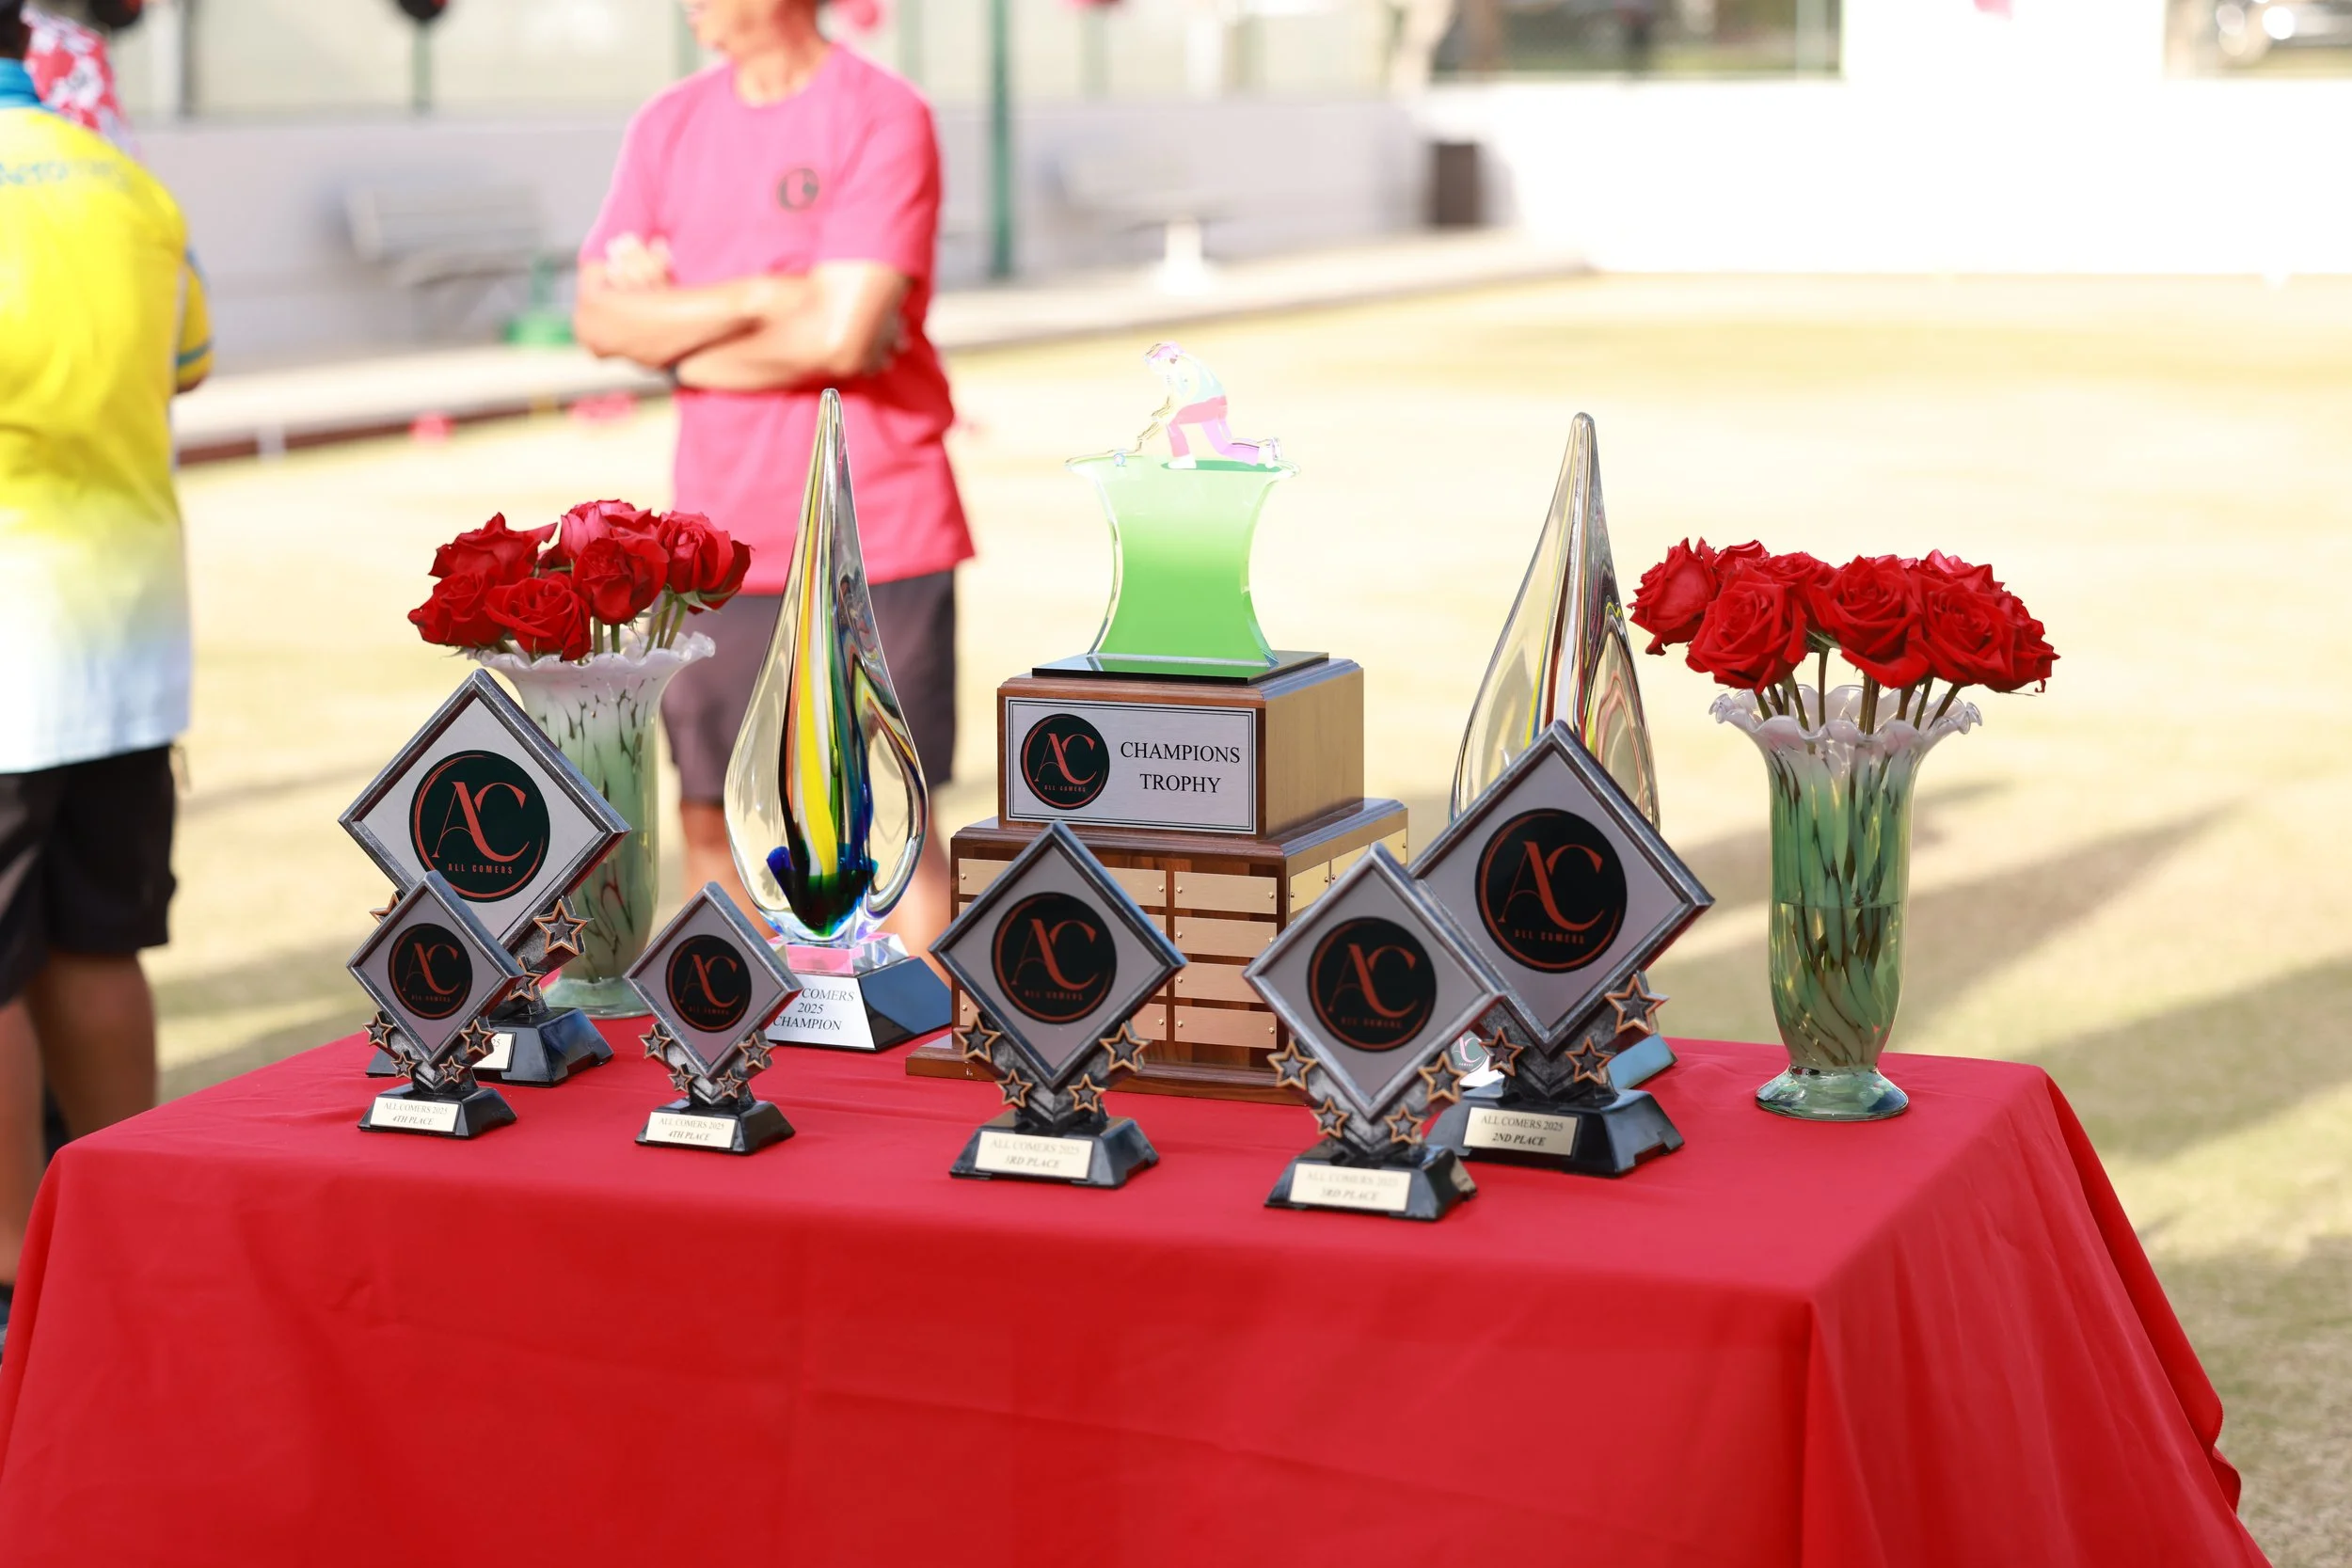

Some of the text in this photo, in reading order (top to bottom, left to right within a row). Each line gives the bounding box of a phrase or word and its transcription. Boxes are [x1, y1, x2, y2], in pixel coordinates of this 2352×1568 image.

[1034, 734, 1097, 784] AC
[1120, 741, 1240, 764] CHAMPIONS
[1140, 773, 1221, 793] TROPHY
[432, 781, 530, 863] AC
[448, 863, 513, 875] ALL COMERS
[1498, 841, 1604, 931] AC
[1011, 918, 1099, 990] AC
[402, 942, 461, 995] AC
[679, 954, 739, 1008] AC
[1327, 943, 1418, 1019] AC
[802, 987, 855, 1002] COMERS
[797, 1002, 824, 1015] 2025
[772, 1016, 842, 1030] CHAMPION
[384, 1101, 448, 1115] ALL COMERS 2025
[408, 1117, 435, 1125] PLACE
[659, 1117, 672, 1126] ALL
[675, 1118, 707, 1129] COMERS
[1482, 1115, 1564, 1132] ALL COMERS 2025
[668, 1130, 710, 1140] 4TH PLACE
[1492, 1132, 1546, 1146] 2ND PLACE
[1025, 1157, 1060, 1168] PLACE
